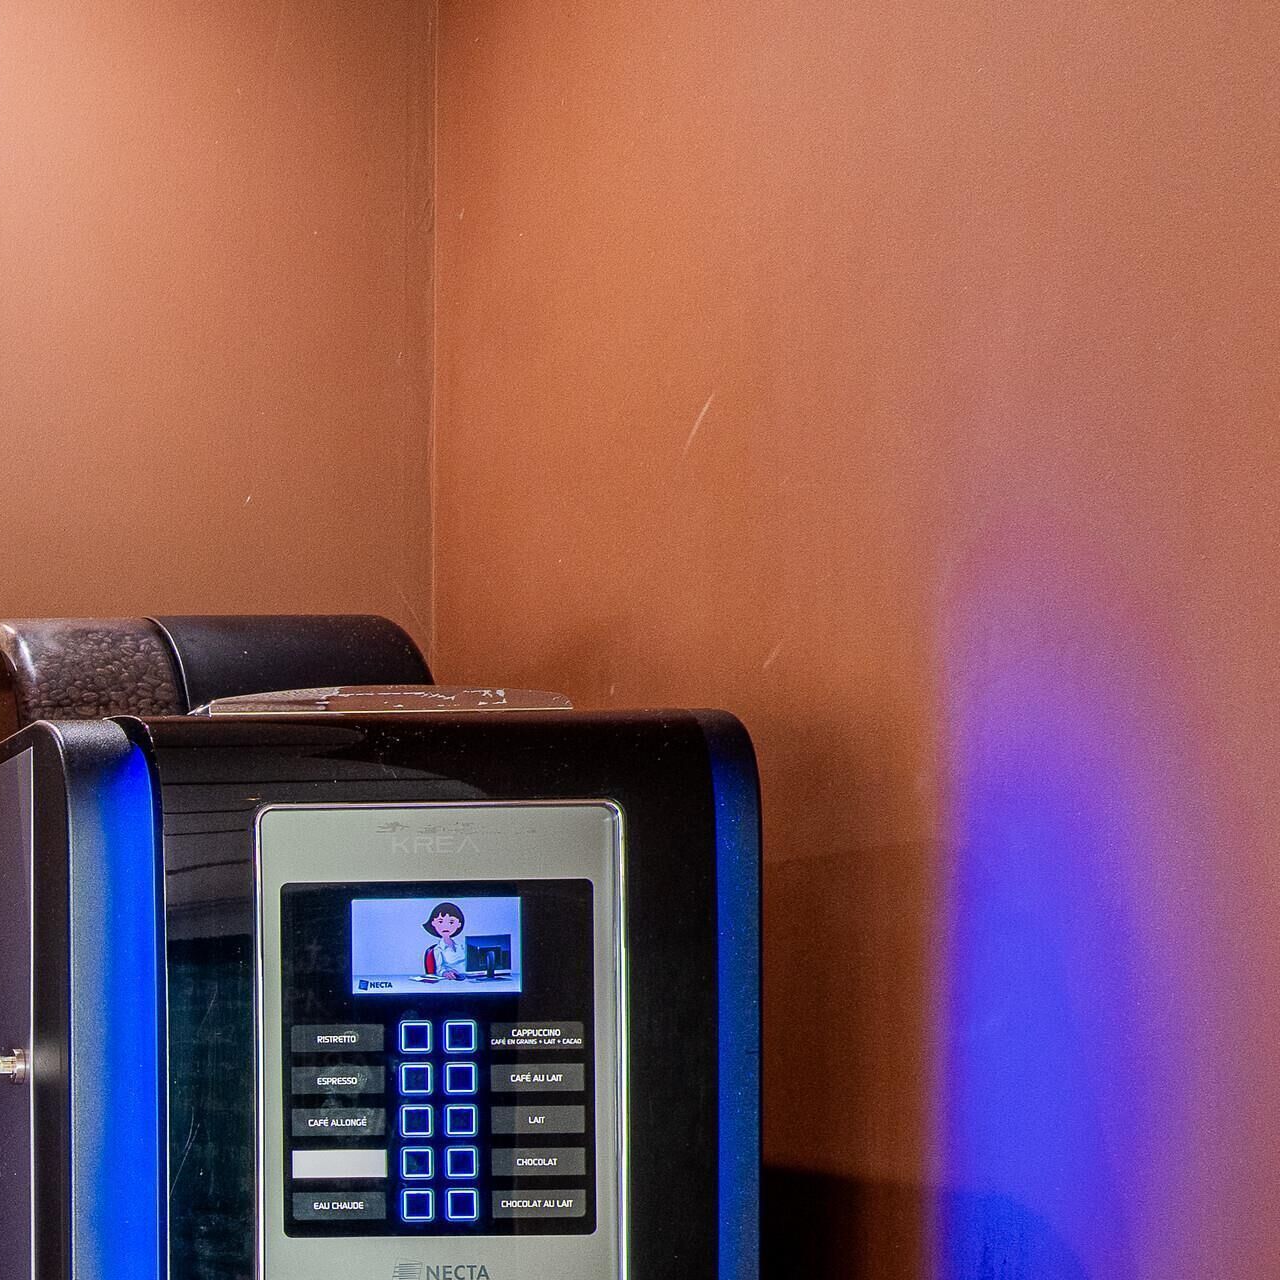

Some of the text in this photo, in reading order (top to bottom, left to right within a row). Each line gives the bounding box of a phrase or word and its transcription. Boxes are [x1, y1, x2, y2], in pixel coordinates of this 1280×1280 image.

[511, 1028, 561, 1037] CAPPUCCINO
[316, 1034, 357, 1044] RISTRETTO
[316, 1076, 358, 1086] ESPRESSO
[510, 1072, 563, 1083] CAFÉ AU LAIT
[308, 1115, 368, 1127] CAFÉ ALLONGÉ
[528, 1116, 546, 1124] LAIT
[516, 1157, 558, 1167] CHOCOLAT
[313, 1201, 365, 1210] EAU CHAUDE
[501, 1199, 574, 1208] CHOCOLAT AU LAIT
[425, 1264, 491, 1280] NECTA
